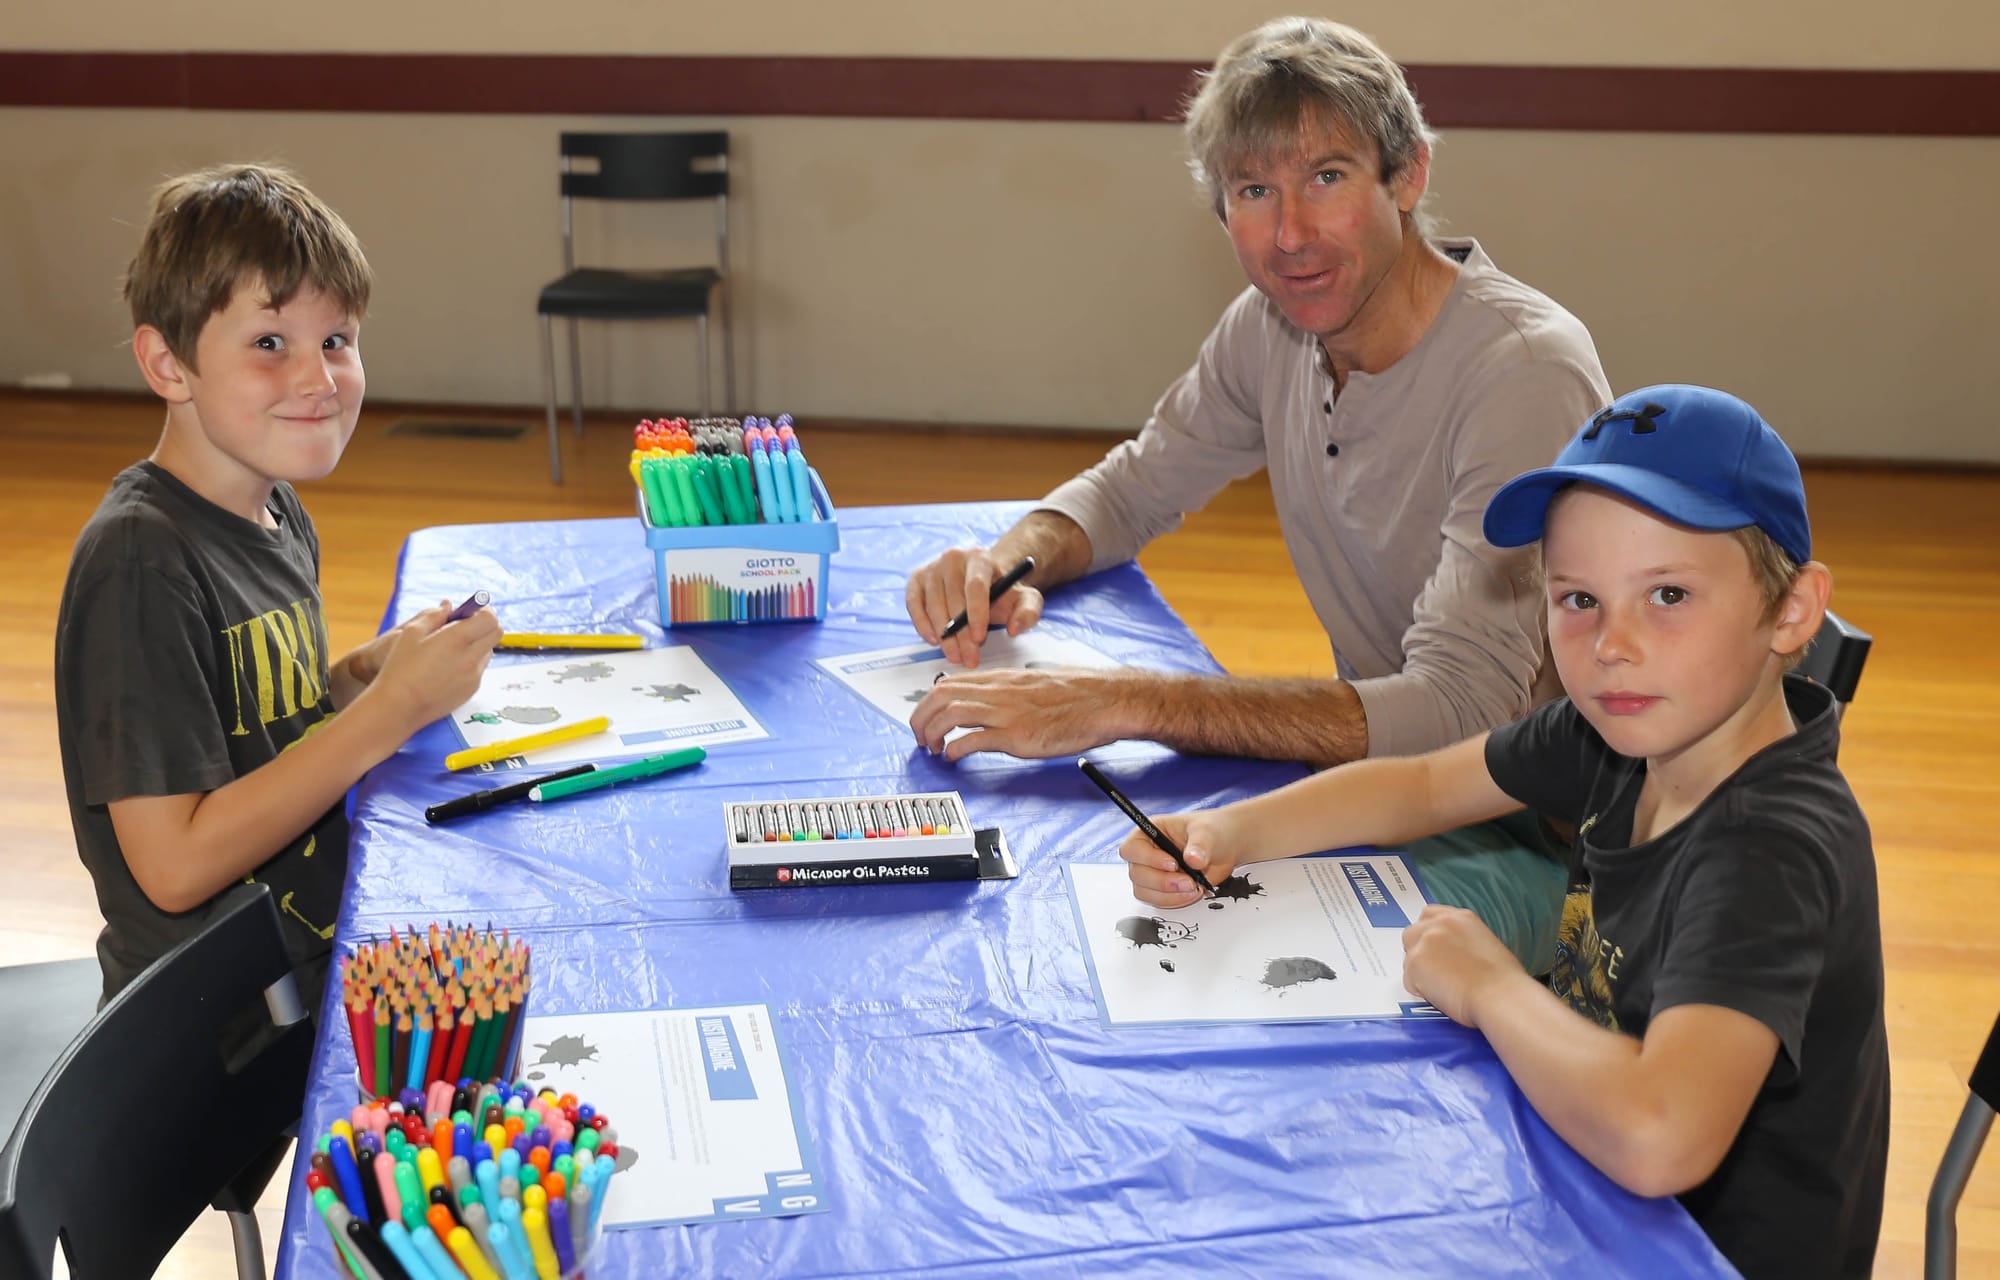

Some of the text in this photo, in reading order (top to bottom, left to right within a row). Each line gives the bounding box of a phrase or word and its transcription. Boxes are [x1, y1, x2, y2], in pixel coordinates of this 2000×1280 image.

[746, 557, 795, 568] GIOTTO
[740, 568, 801, 577] SCHOOL PACK
[1344, 864, 1370, 878] JUST
[1353, 876, 1387, 906] IMAGINE
[700, 1018, 737, 1072] JUST IMAGINE
[724, 1200, 761, 1212] V
[781, 1195, 817, 1209] G
